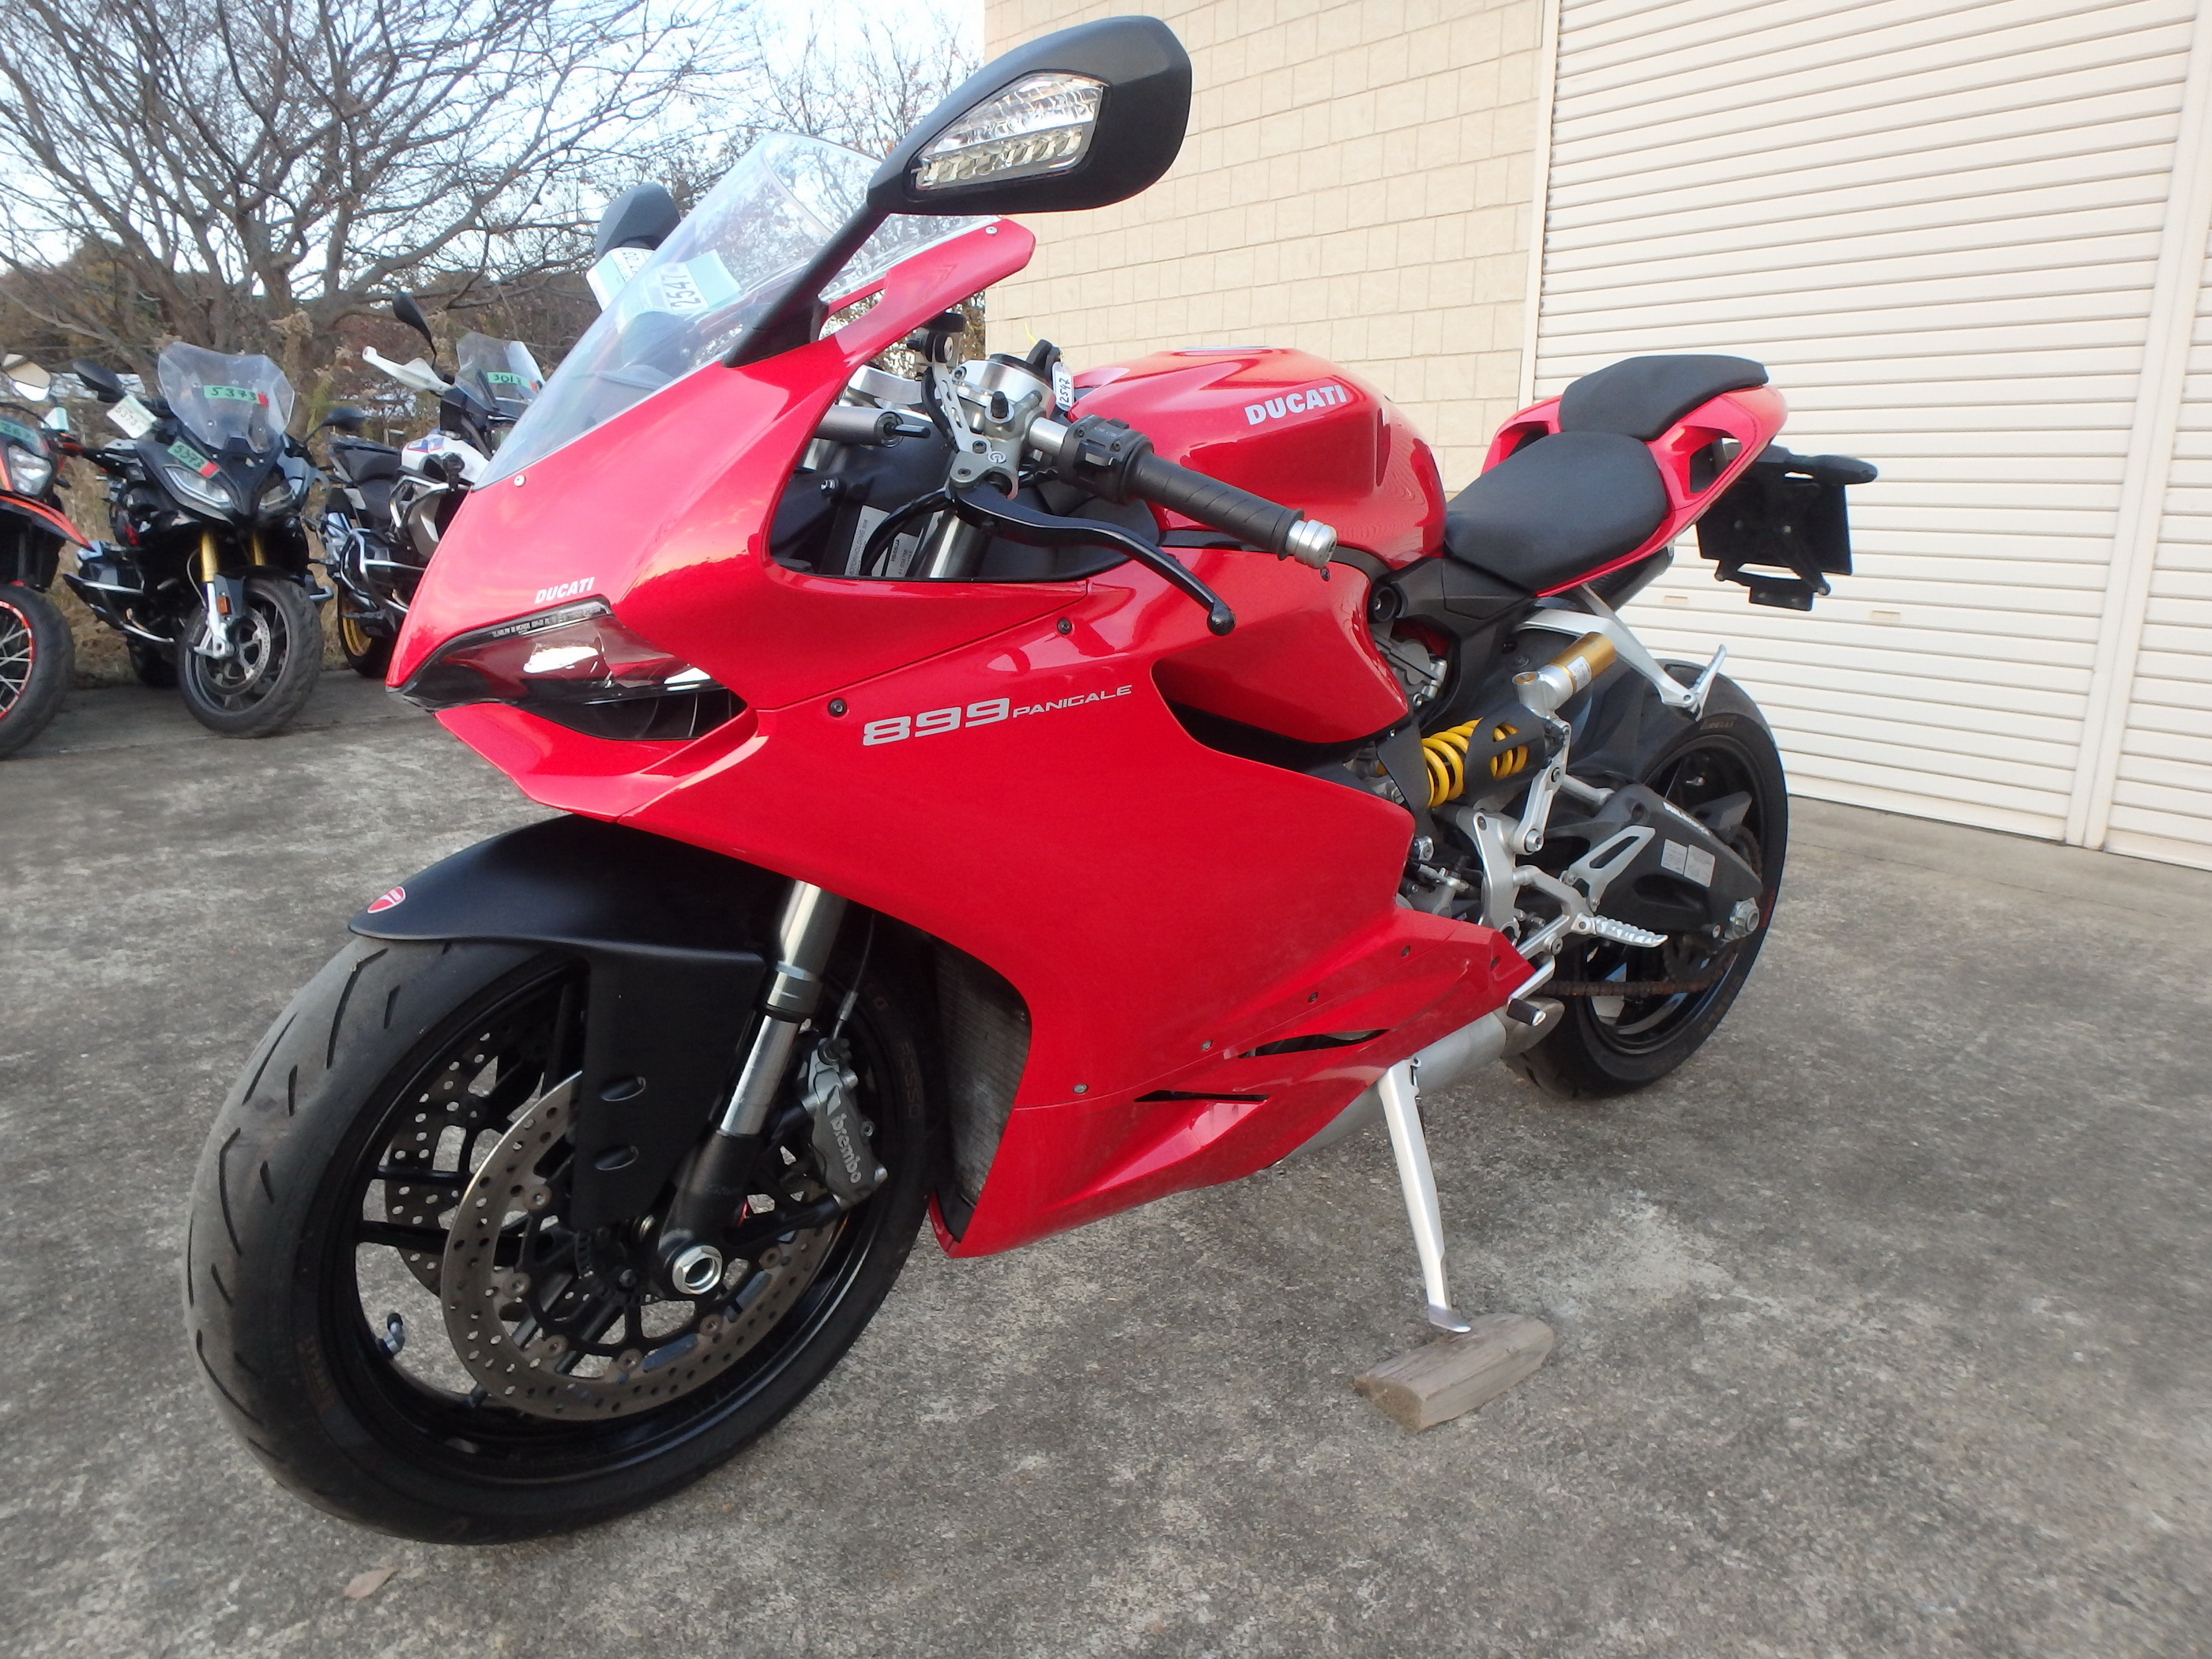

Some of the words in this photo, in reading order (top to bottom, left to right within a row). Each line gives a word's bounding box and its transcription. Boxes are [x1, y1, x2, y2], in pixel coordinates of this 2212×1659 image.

[212, 386, 257, 401] 5373
[1059, 378, 1070, 403] 2547
[1244, 384, 1347, 426] DUCATI
[534, 577, 595, 604] DUCATI
[862, 697, 1010, 747] 899
[1012, 684, 1133, 719] PANIGALE
[830, 1112, 862, 1183] brembo
